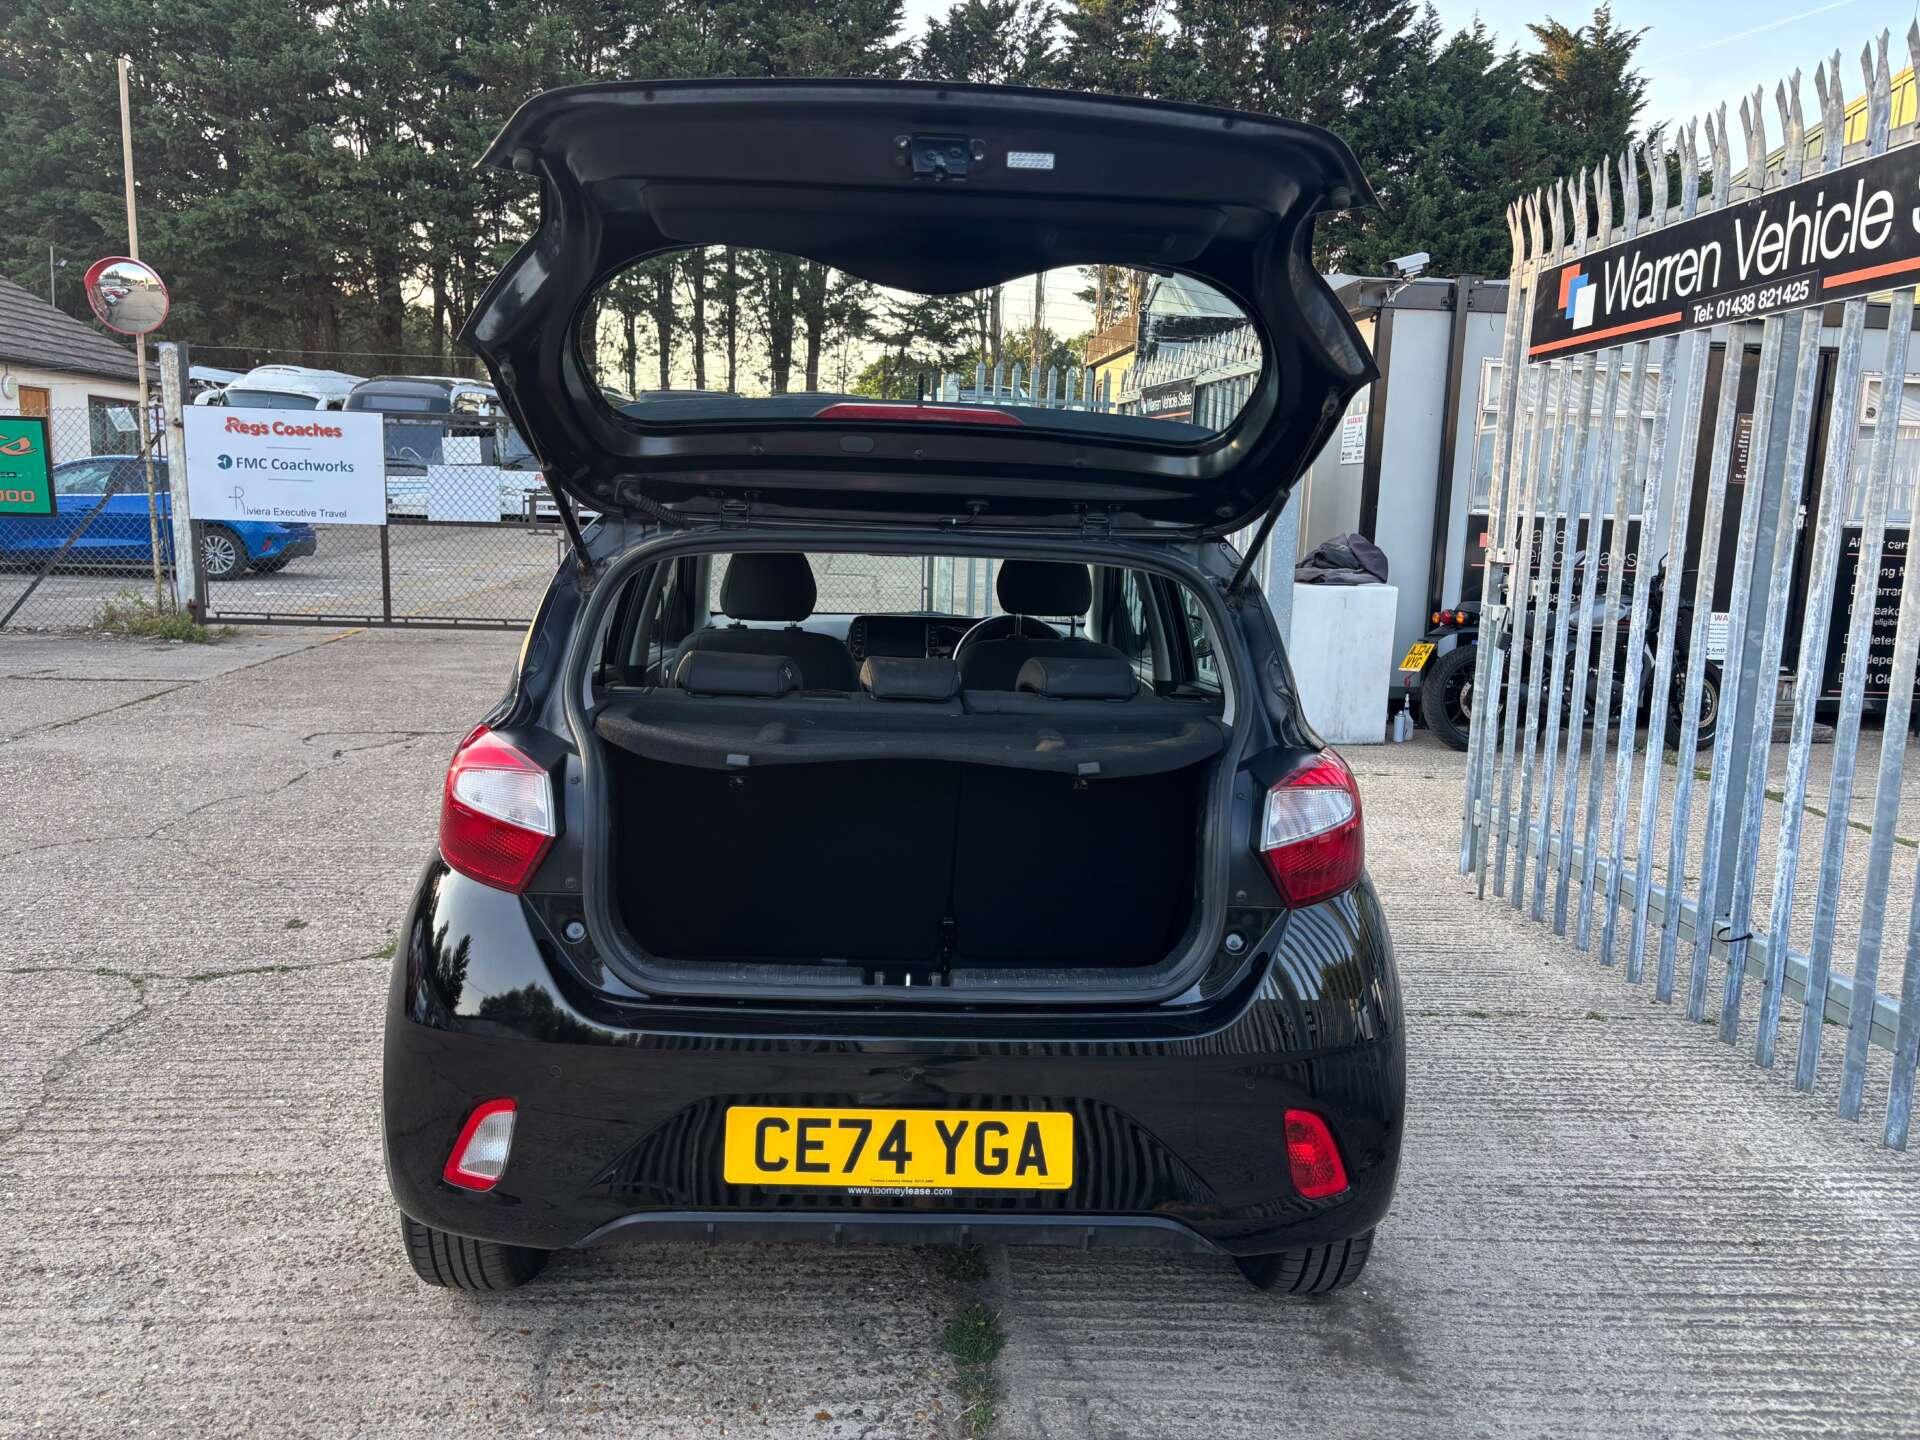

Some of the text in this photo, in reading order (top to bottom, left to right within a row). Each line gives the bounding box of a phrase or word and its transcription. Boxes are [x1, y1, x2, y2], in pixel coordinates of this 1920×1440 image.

[1604, 241, 1721, 315] Warren
[1735, 178, 1894, 281] Vehicle
[1693, 280, 1810, 323] Tel: 01438 821425
[272, 421, 343, 438] Coaches
[236, 456, 354, 473] FMC Coachworks
[228, 485, 347, 519] Riviera Executive Travel
[754, 1117, 1048, 1176] CE74 YGA
[847, 1186, 953, 1197] www.toomeylease.com
